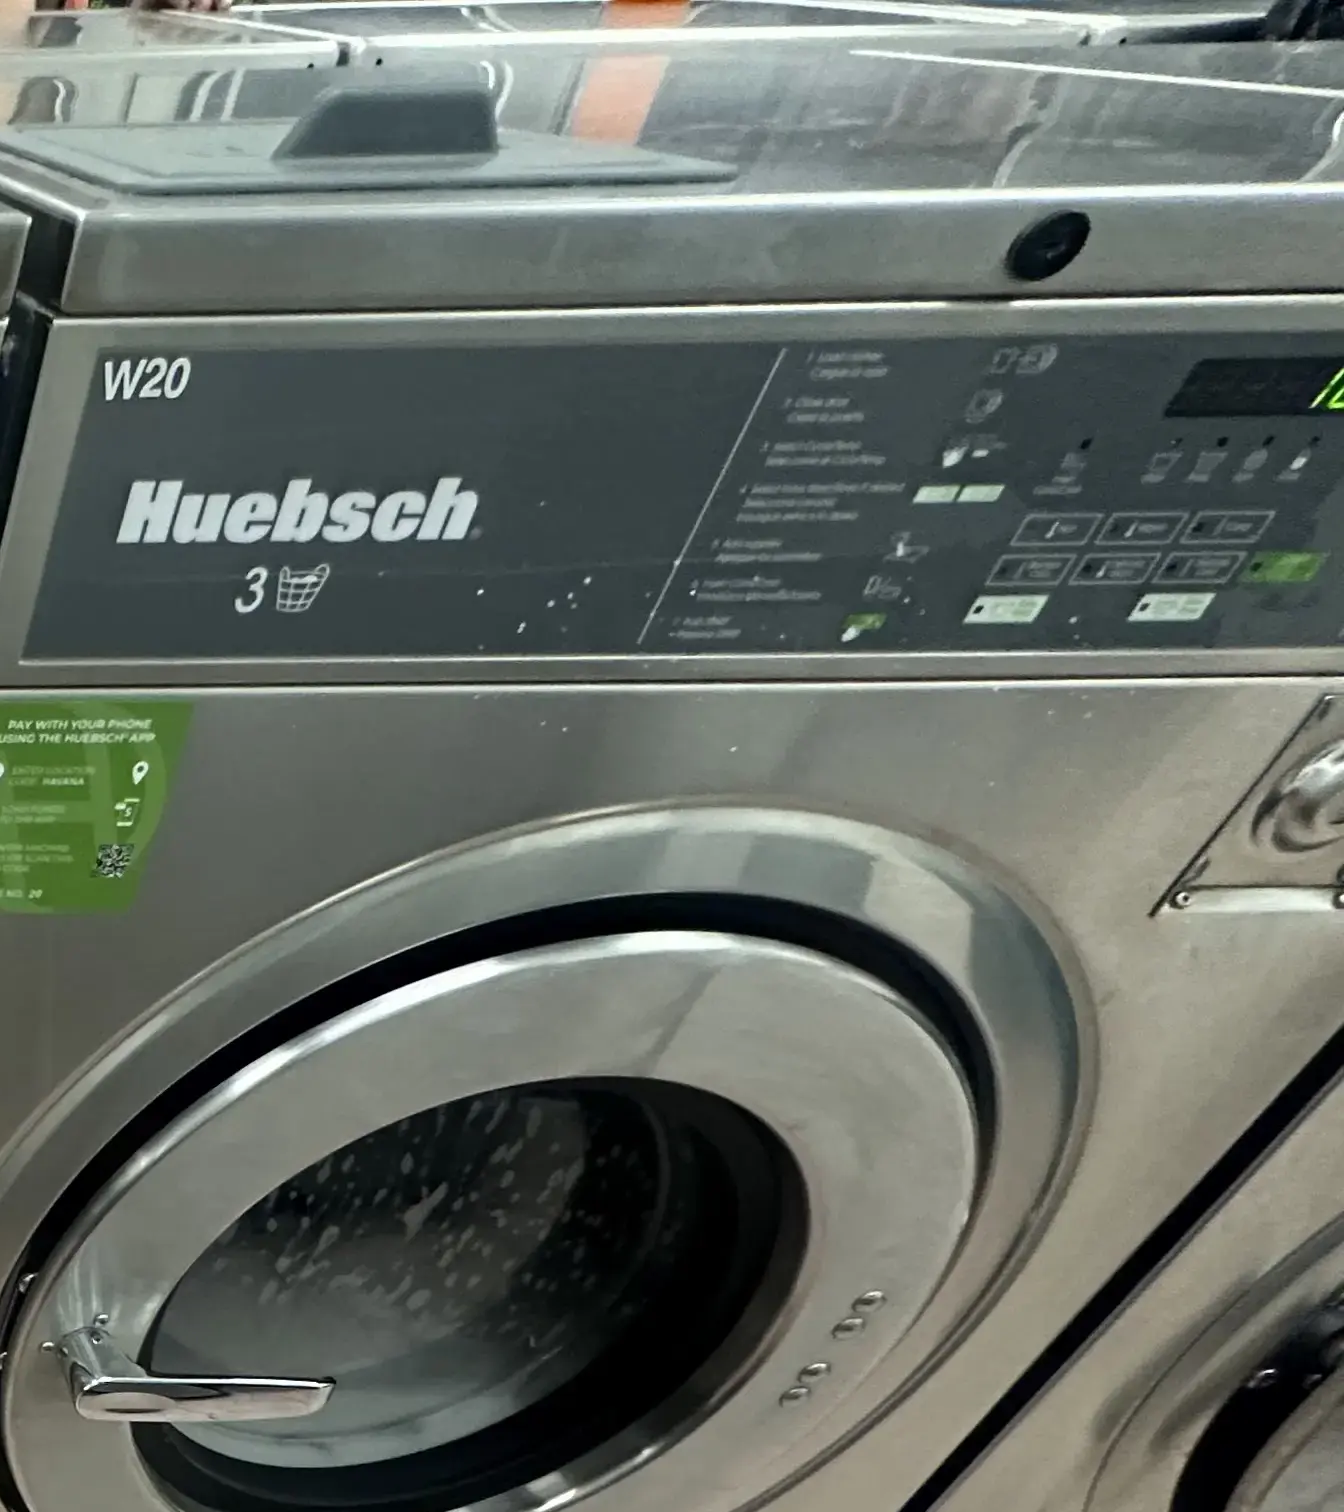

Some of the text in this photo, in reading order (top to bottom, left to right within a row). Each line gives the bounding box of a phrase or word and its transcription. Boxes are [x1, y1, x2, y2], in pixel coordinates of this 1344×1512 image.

[105, 357, 191, 400] W20
[116, 477, 478, 543] Huebsch
[234, 567, 267, 613] 3
[7, 718, 153, 730] PAY WITH YOUR PHONE
[39, 733, 61, 744] THE
[128, 732, 156, 743] APP
